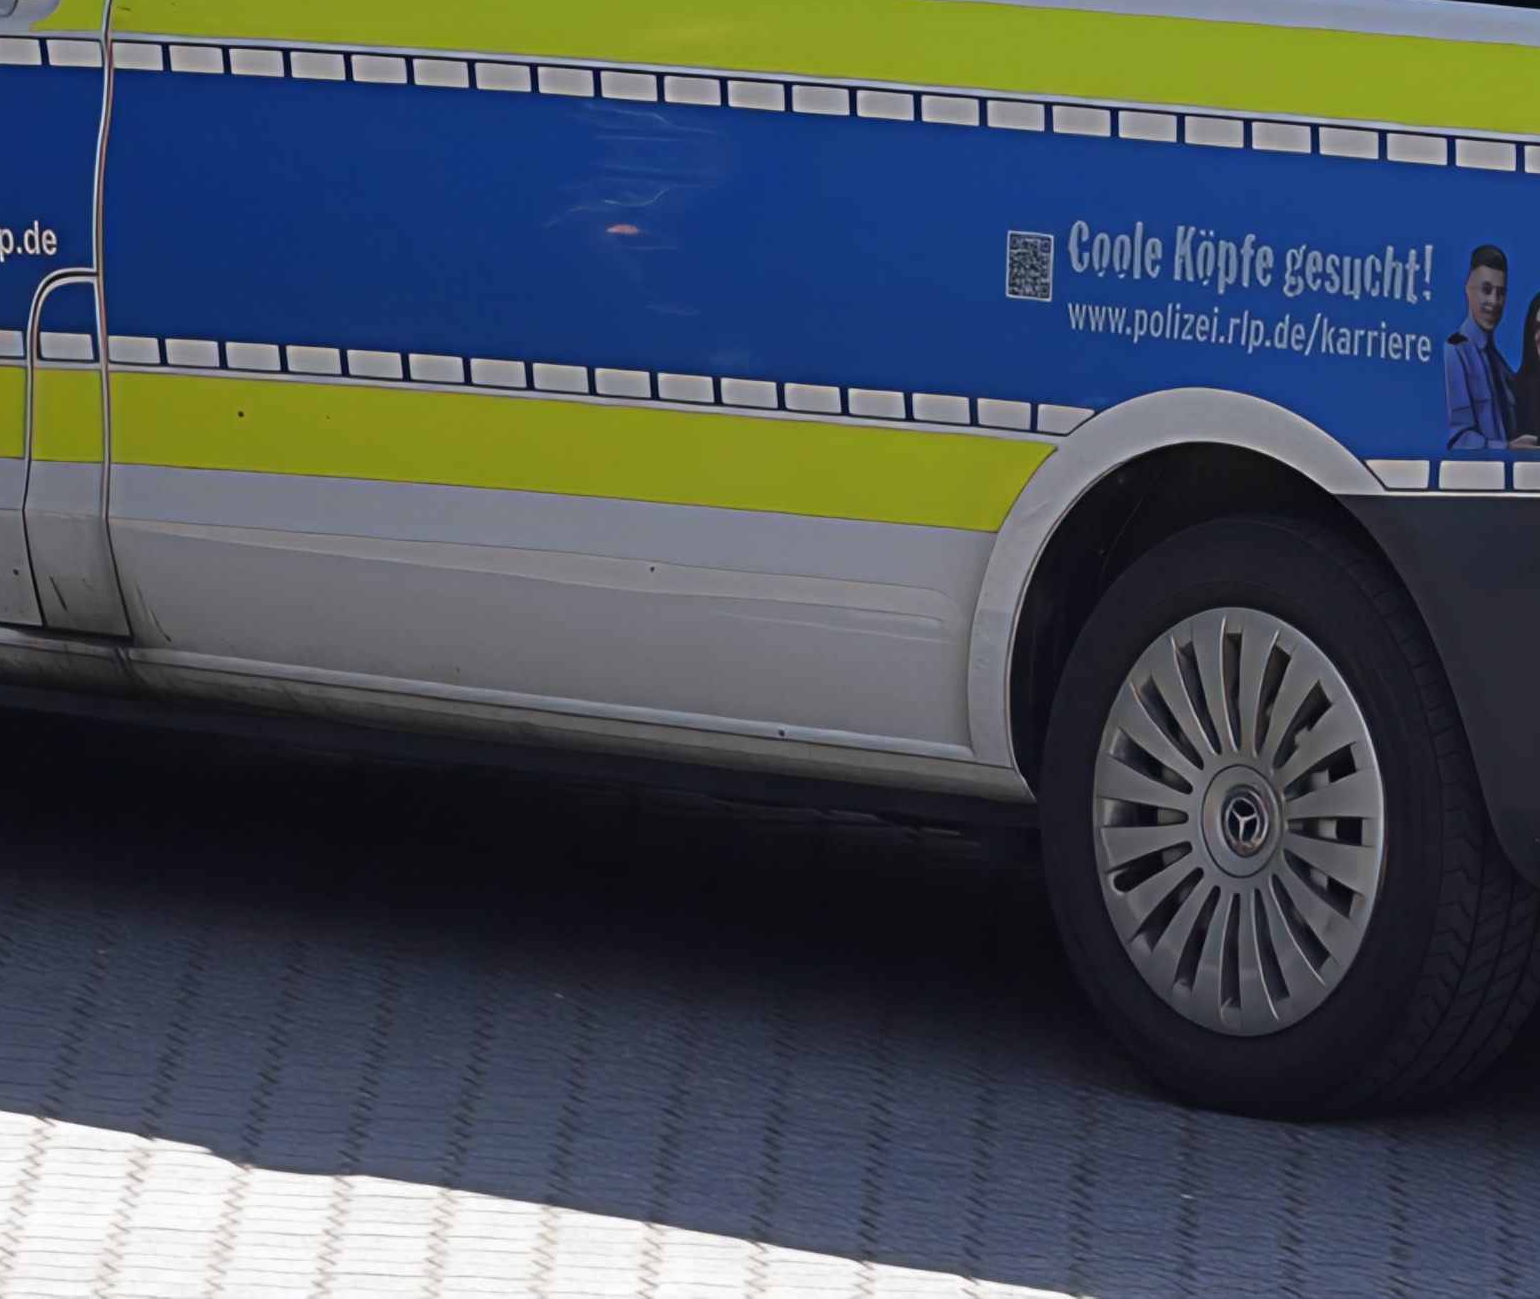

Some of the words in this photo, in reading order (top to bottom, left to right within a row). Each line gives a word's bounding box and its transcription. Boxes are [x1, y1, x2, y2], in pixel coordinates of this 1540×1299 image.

[1067, 219, 1163, 281] Coole
[1173, 224, 1275, 296] Köpfe
[1282, 243, 1435, 305] gesucht!
[1067, 301, 1433, 364] www.polizei.rlp.de/karriere
